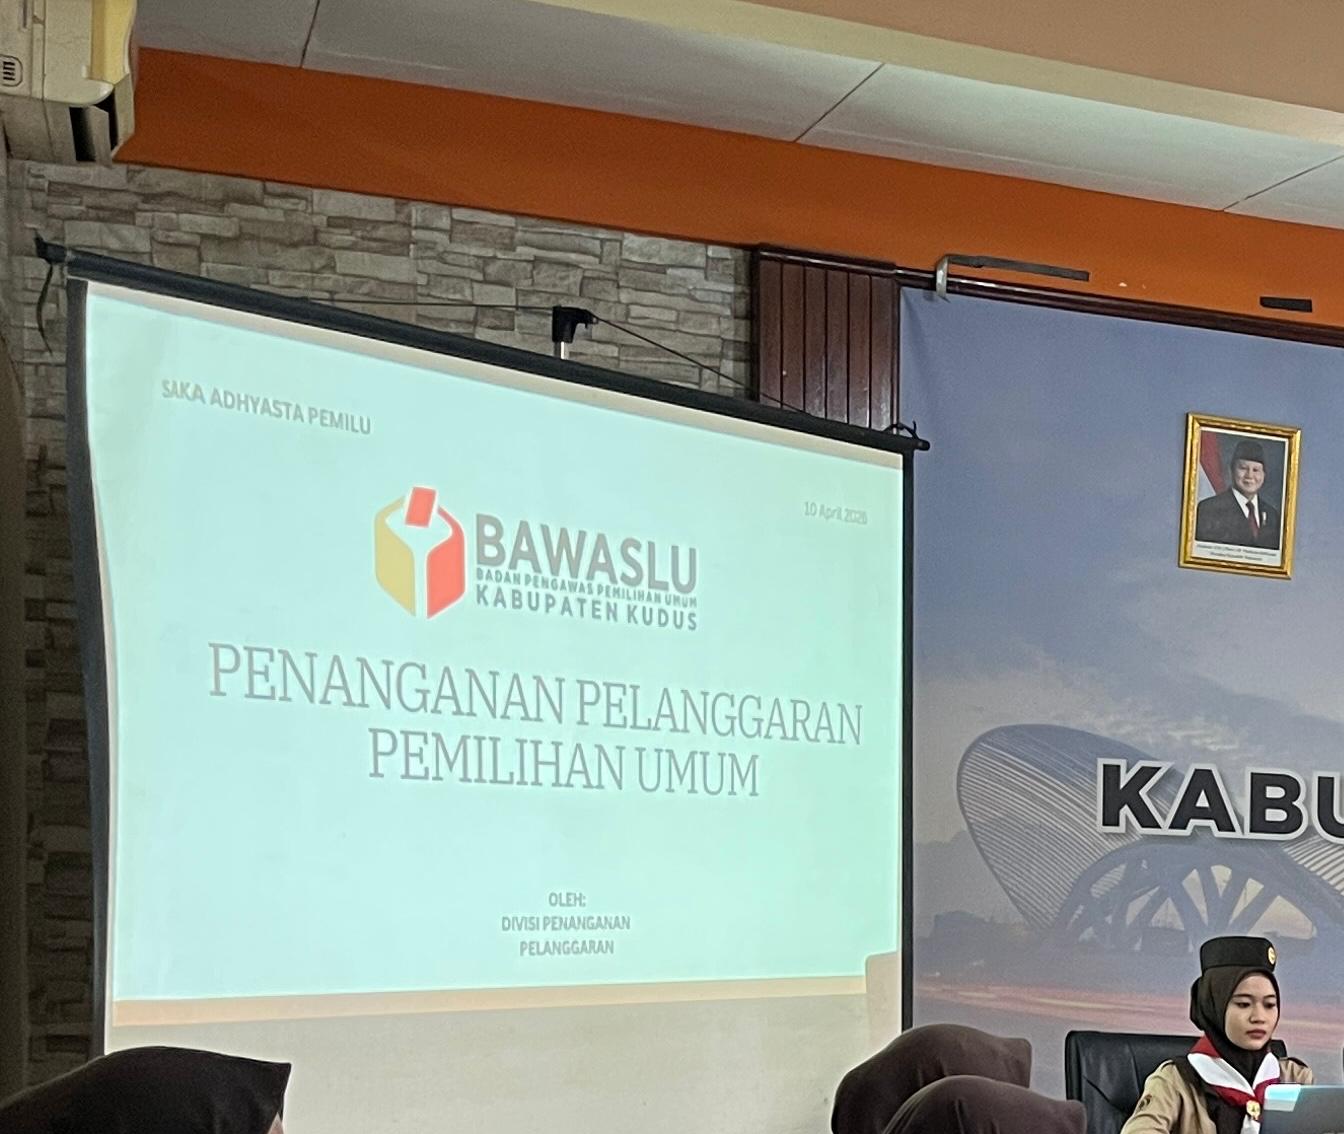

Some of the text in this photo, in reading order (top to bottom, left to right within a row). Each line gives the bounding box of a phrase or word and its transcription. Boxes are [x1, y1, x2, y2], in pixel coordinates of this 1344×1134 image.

[161, 379, 371, 435] SAKA ADHYASTA PEMILU
[476, 513, 697, 594] BAWASLU
[476, 567, 697, 609] BADAN PENGAWAS PEMILIHAN UMUM
[476, 584, 697, 631] KABUPATEN KUDUS
[208, 642, 863, 745] PENANGANAN PELANGGARAN
[368, 728, 759, 797] PEMILIHAN UMUM
[501, 915, 631, 931] DIVISI PENANGANAN
[548, 892, 586, 907] OLEH:
[519, 939, 614, 956] PELANGGARAN
